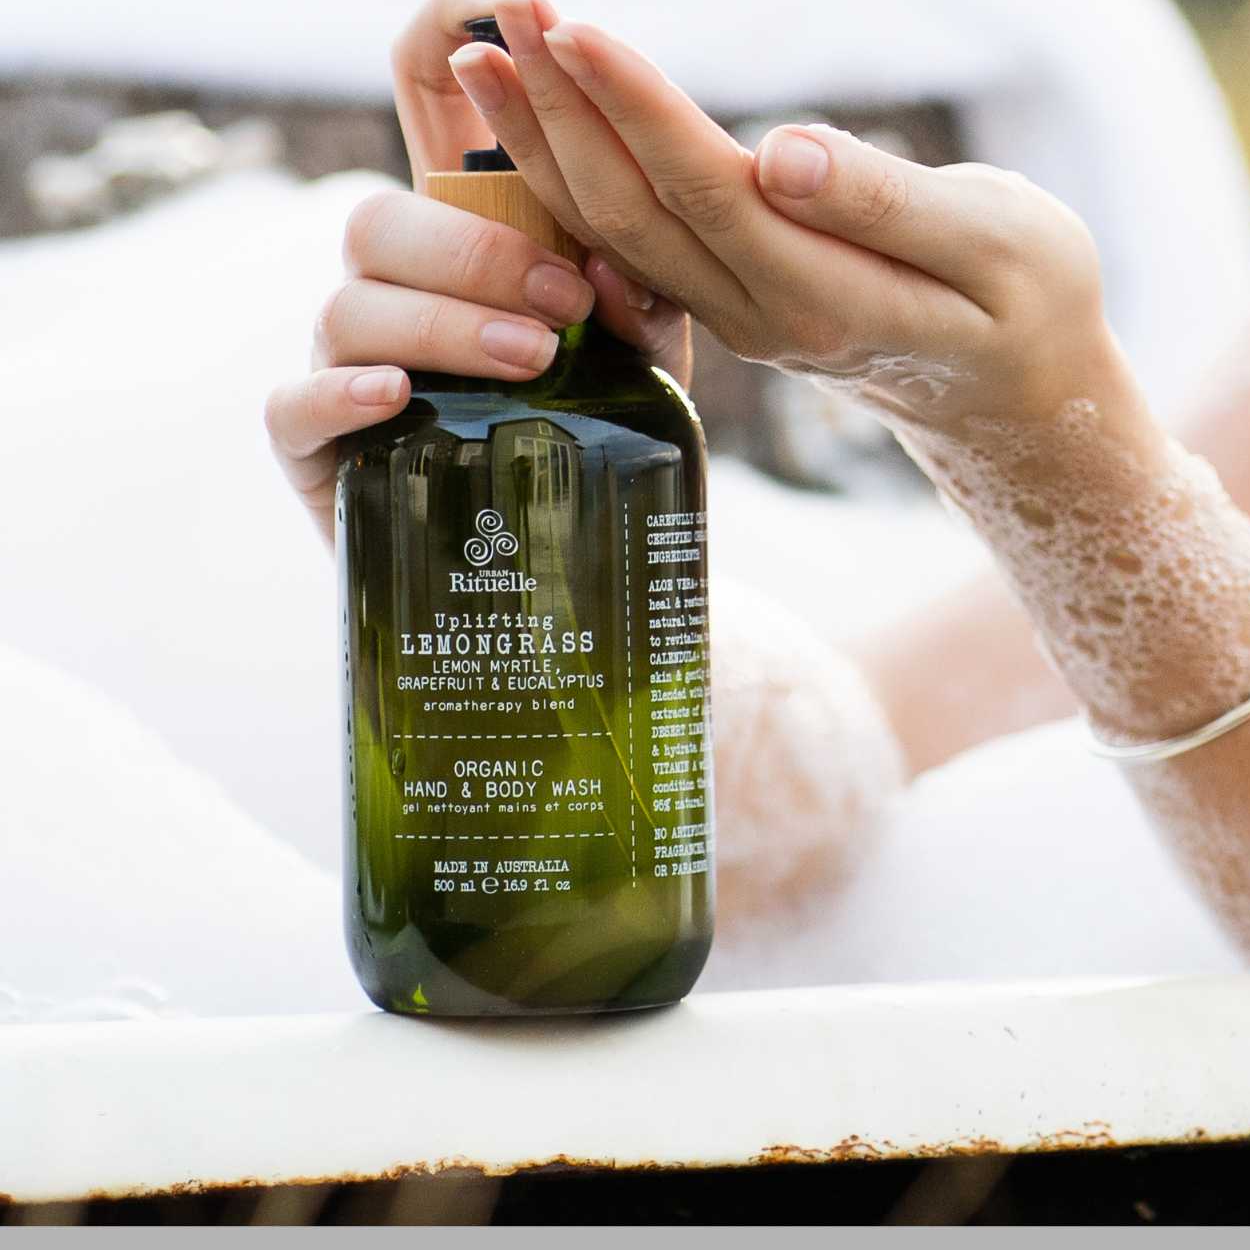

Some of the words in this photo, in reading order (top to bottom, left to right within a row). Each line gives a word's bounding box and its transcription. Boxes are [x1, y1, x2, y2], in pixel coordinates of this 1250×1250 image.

[449, 572, 537, 592] Rituelle
[648, 579, 673, 592] ALOE
[648, 597, 671, 611] heal
[435, 613, 553, 631] Uplifting
[649, 615, 686, 628] natural
[401, 631, 594, 655] LEMONGRASS
[650, 635, 661, 647] to
[433, 660, 480, 674] LEMON
[490, 659, 561, 675] MYRTLE,
[397, 676, 484, 691] GRAPEFRUIT
[491, 676, 500, 691] &
[508, 674, 604, 690] EUCALYPTUS
[424, 699, 522, 713] aromatherapy
[532, 698, 575, 711] blend
[454, 760, 544, 777] ORGANIC
[404, 781, 447, 798] HAND
[461, 781, 471, 799] &
[486, 781, 537, 798] BODY
[552, 779, 602, 796] WASH
[402, 802, 419, 815] gel
[427, 802, 490, 815] nettoyant
[499, 802, 537, 813] mains
[545, 801, 559, 812] et
[568, 800, 604, 813] corps
[654, 828, 667, 840] NO
[434, 861, 468, 874] MADE
[473, 861, 488, 874] IN
[496, 860, 570, 873] AUSTRALIA
[654, 864, 668, 877] OR
[434, 879, 454, 892] 500
[461, 879, 476, 892] ml
[503, 879, 527, 892] 16.9
[534, 879, 549, 891] fl
[556, 880, 570, 891] oz
